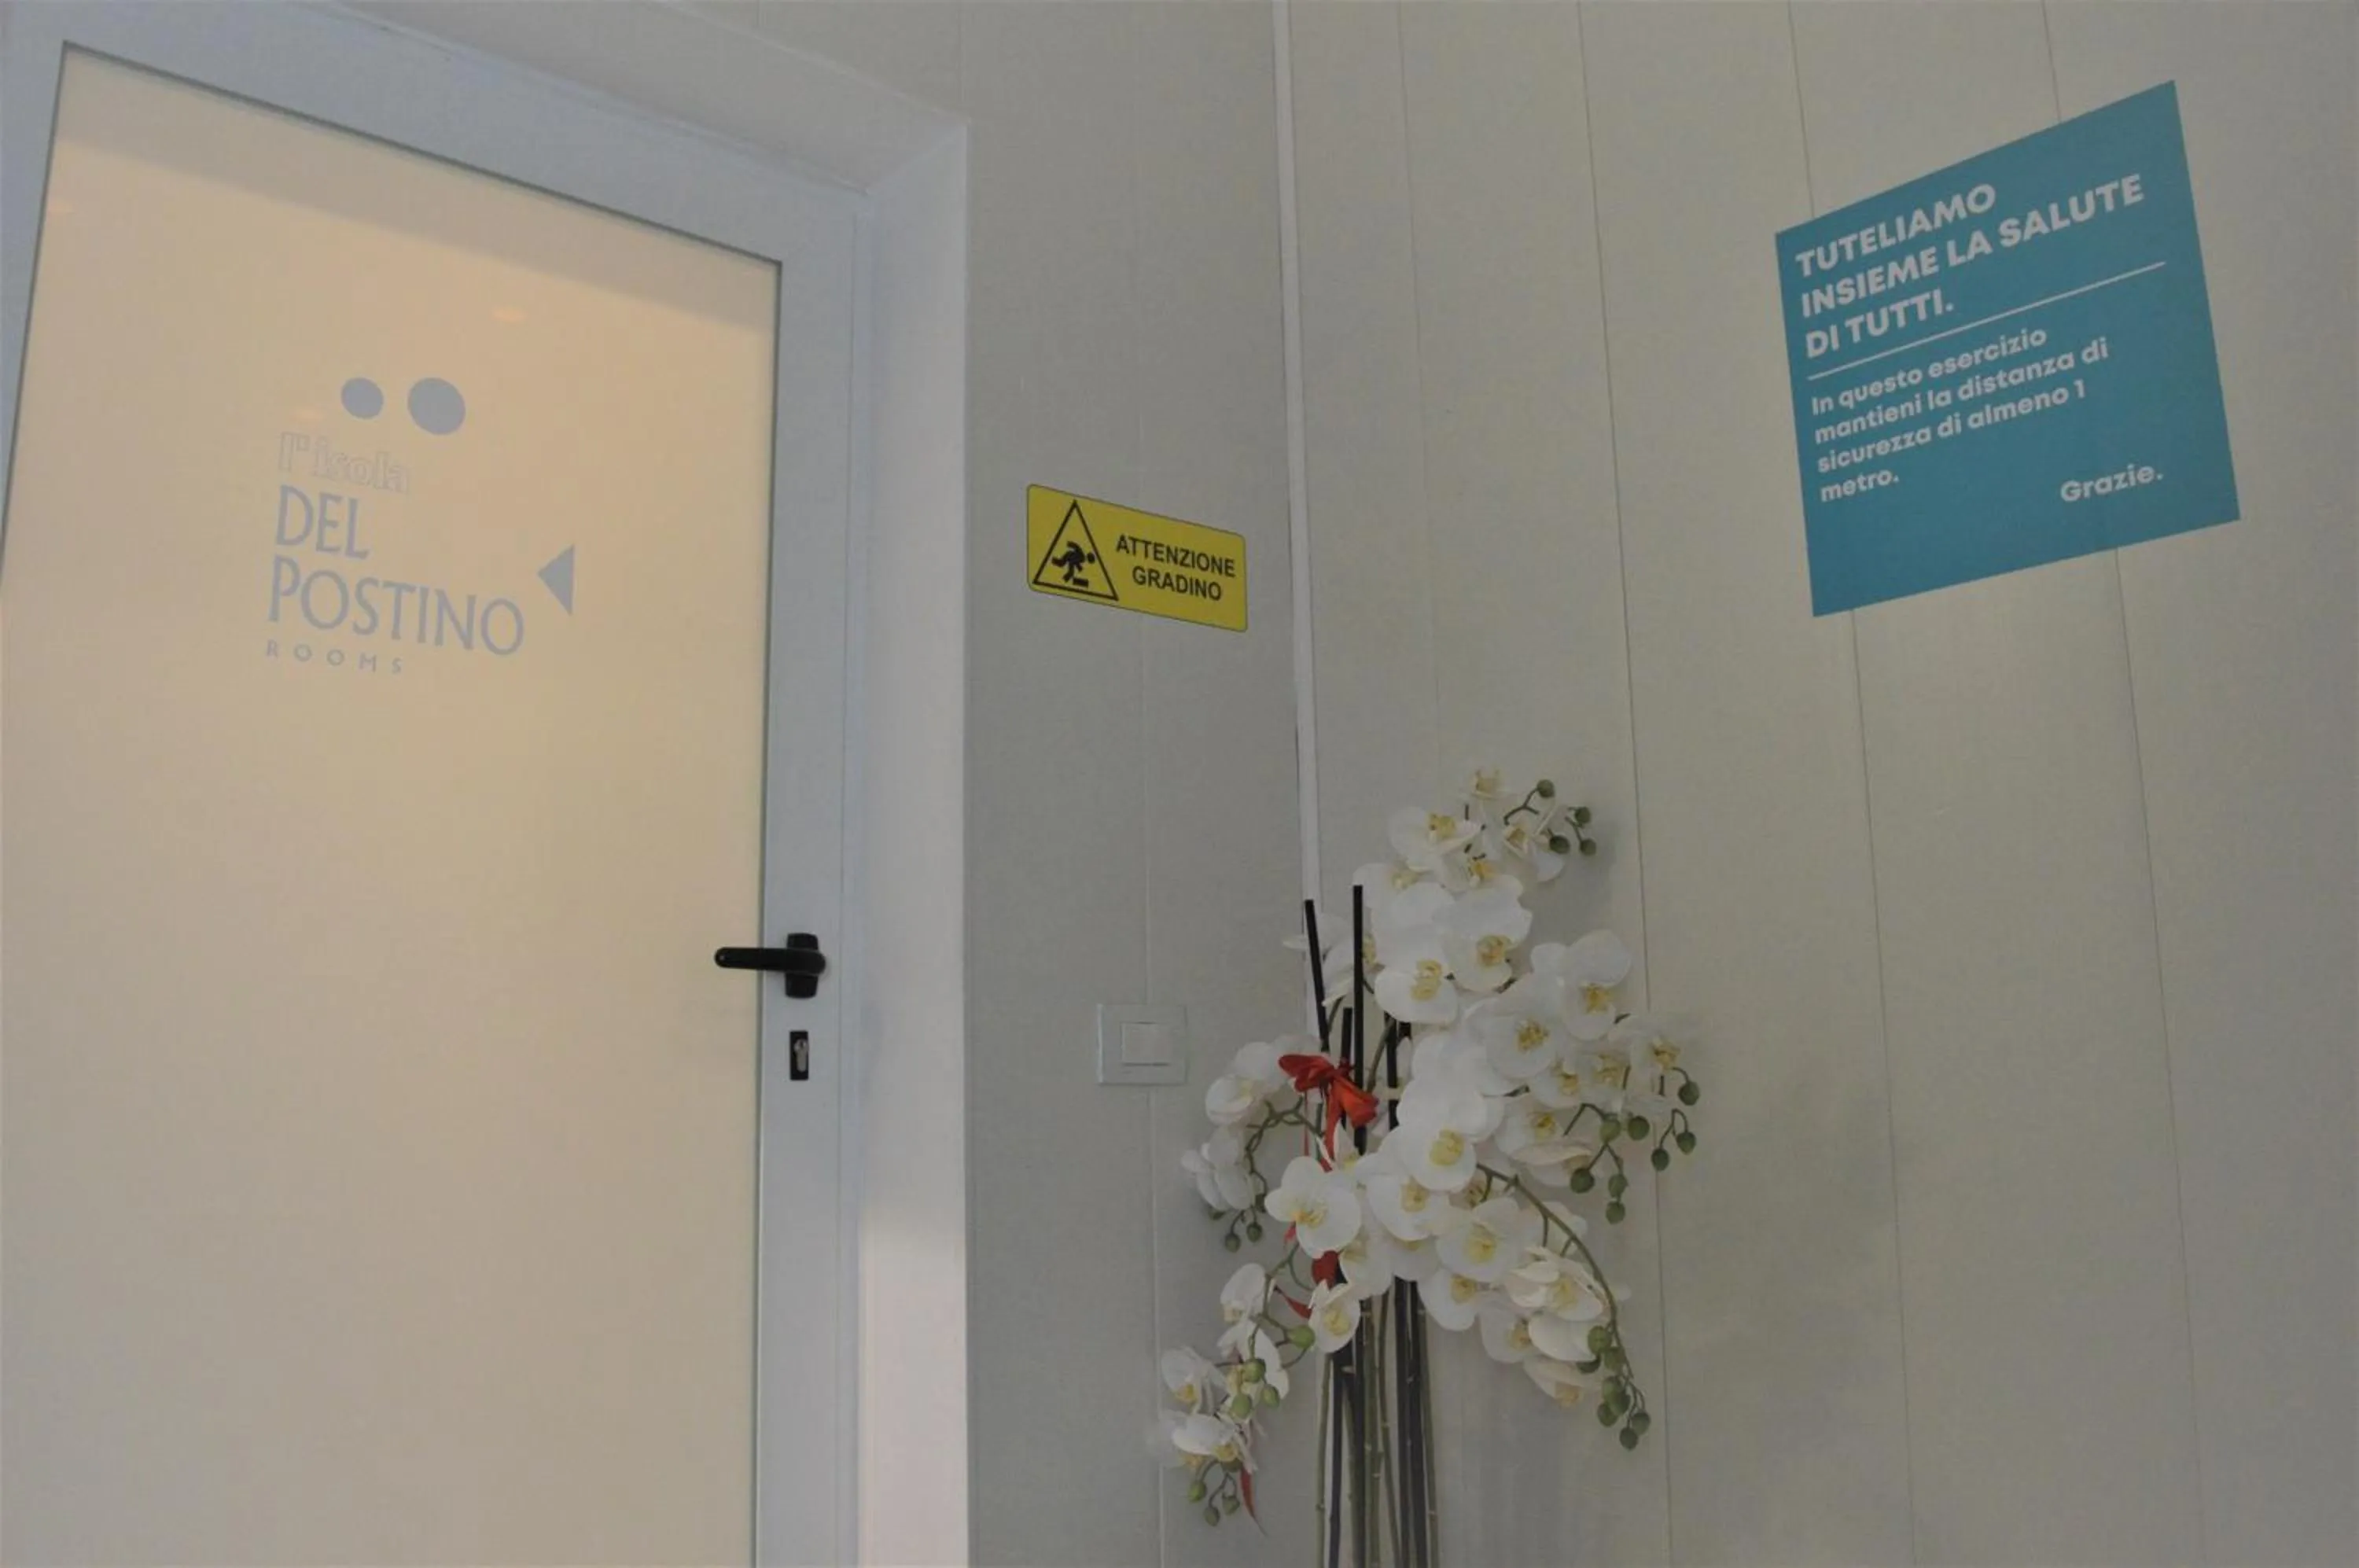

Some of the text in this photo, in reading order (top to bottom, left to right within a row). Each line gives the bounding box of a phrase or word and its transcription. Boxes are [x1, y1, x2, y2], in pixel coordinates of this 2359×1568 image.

[1795, 183, 1996, 278] TUTELIAMO
[1801, 173, 2144, 318] INSIEME LA SALUTE
[1805, 288, 1955, 359] DI TUTTI.
[1812, 328, 2048, 415] In questo esercizio
[1815, 337, 2109, 445] mantieni la distanza di
[1817, 380, 2086, 473] sicurezza di almeno 1
[1820, 467, 1900, 502] metro.
[2060, 462, 2164, 502] Grazie.
[276, 483, 370, 561] DEL
[1116, 534, 1237, 578] ATTENZIONE
[267, 553, 524, 656] POSTINO
[1132, 565, 1223, 602] GRADINO
[266, 639, 403, 674] ROOMS
